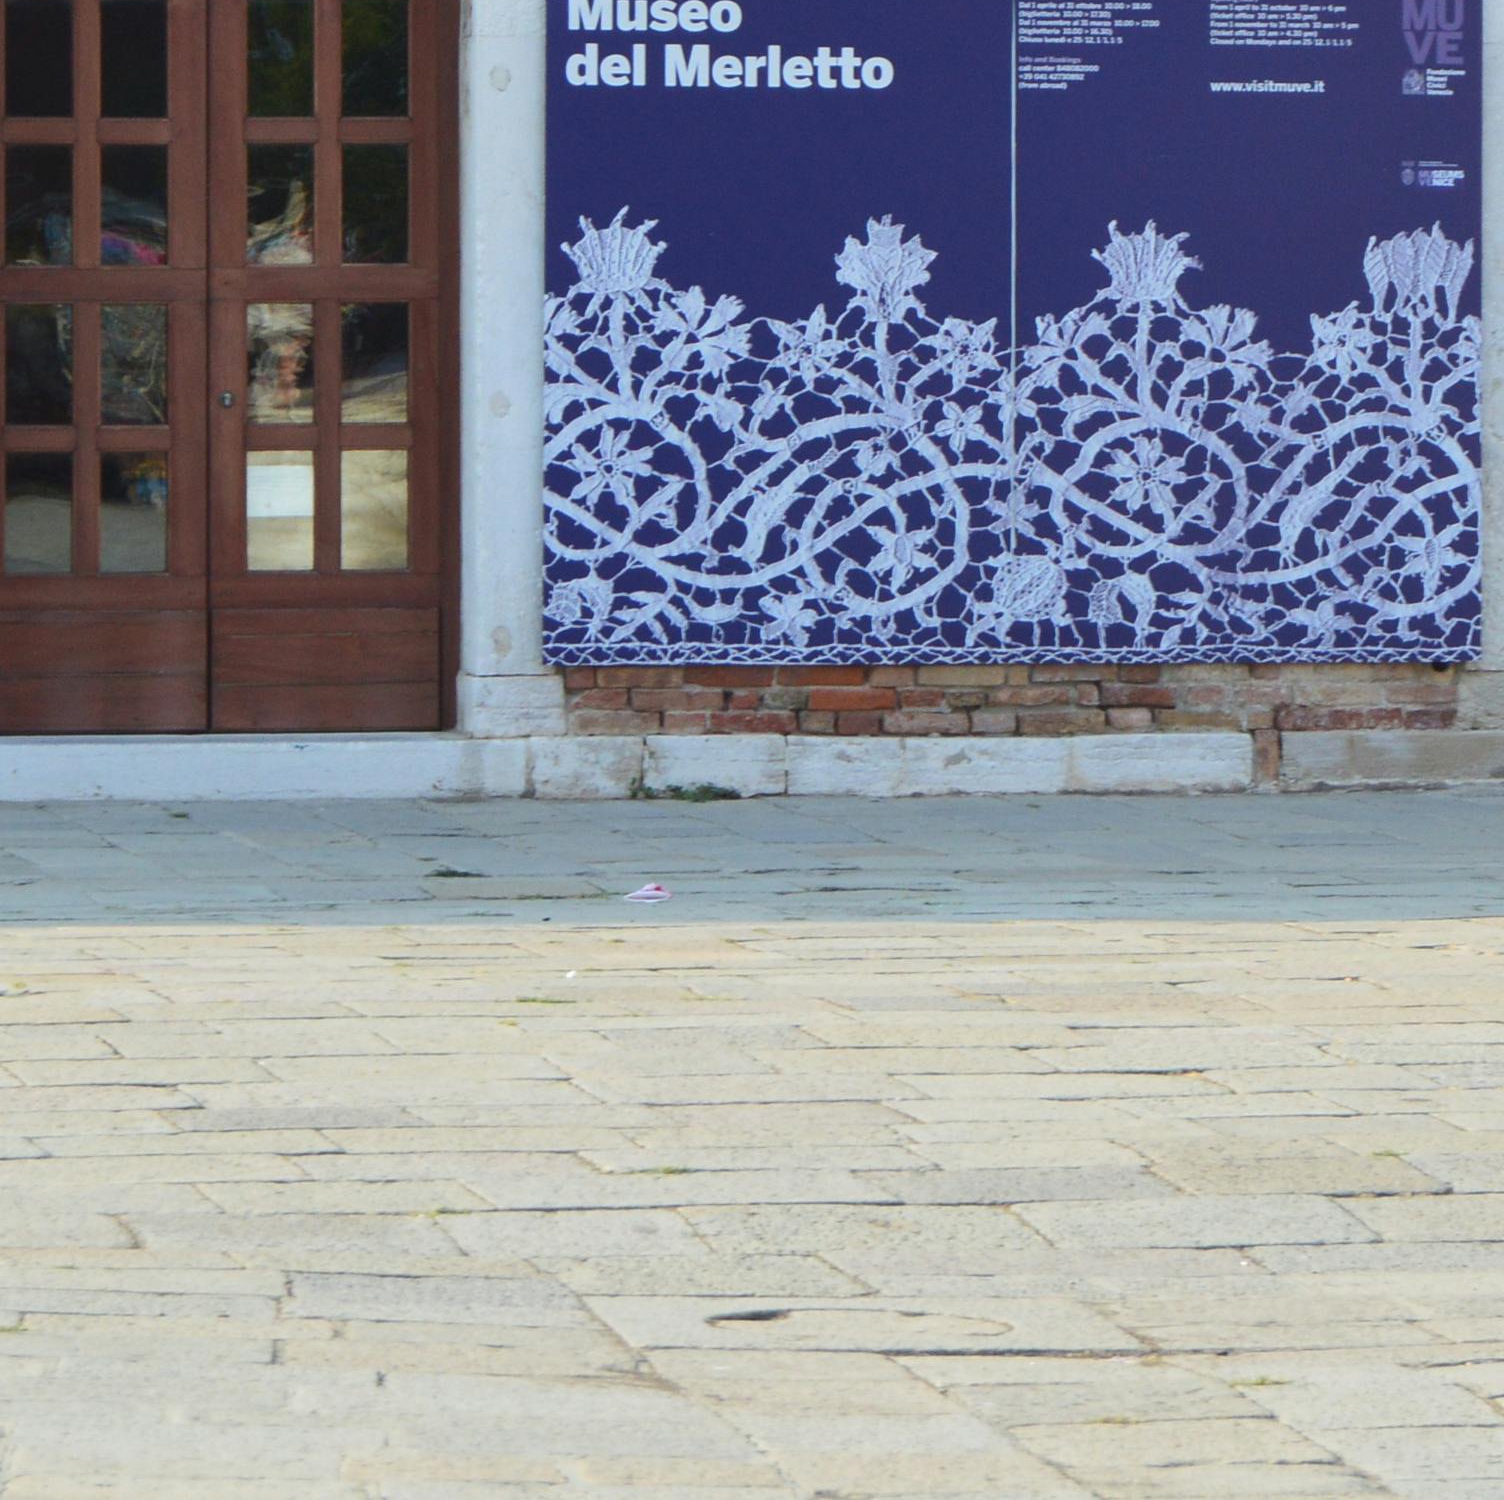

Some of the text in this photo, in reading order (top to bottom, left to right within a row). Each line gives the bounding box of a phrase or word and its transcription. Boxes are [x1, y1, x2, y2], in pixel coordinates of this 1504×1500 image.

[1403, 31, 1464, 64] VE
[565, 43, 895, 90] del Merletto
[1210, 79, 1325, 93] www.visitmuve.it
